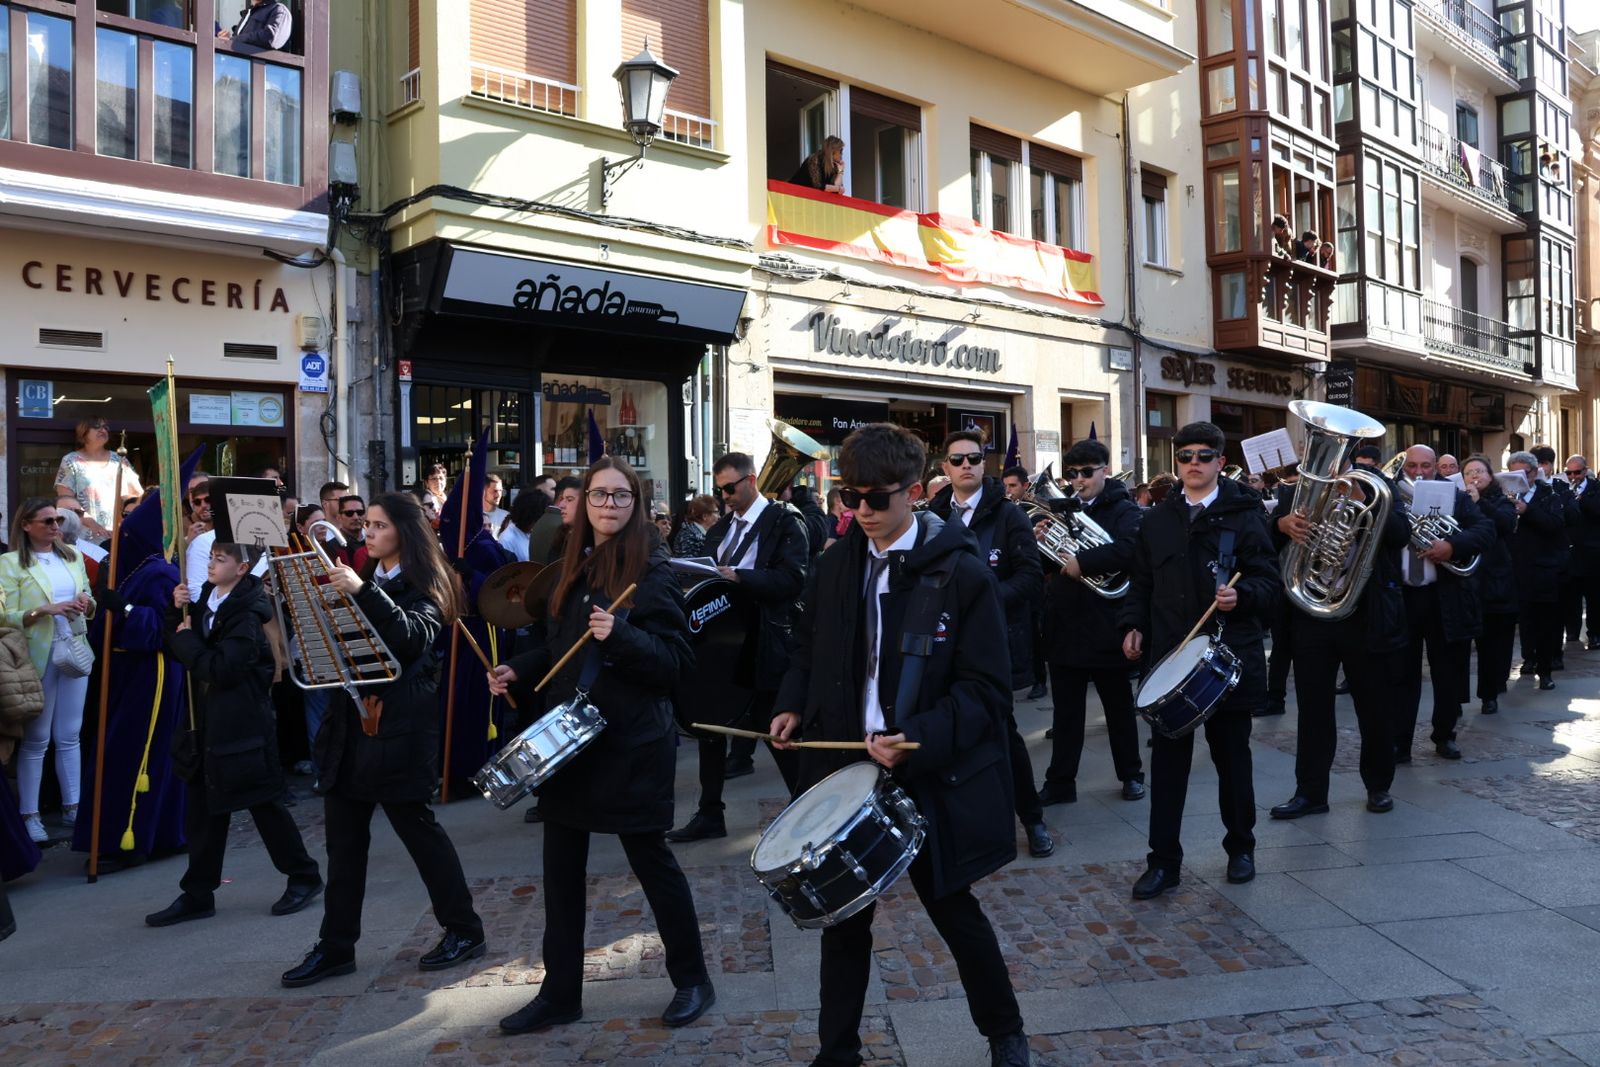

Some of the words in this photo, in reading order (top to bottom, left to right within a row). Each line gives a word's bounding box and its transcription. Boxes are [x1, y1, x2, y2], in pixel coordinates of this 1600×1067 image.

[600, 244, 609, 261] 3
[22, 260, 290, 313] CERVECERÍA
[513, 273, 626, 316] añada
[626, 304, 661, 316] gourmet
[305, 361, 321, 370] ADT
[1160, 352, 1216, 388] SEVER
[1226, 366, 1292, 396] SEGUROS
[25, 384, 46, 400] CB
[832, 416, 848, 429] Pan
